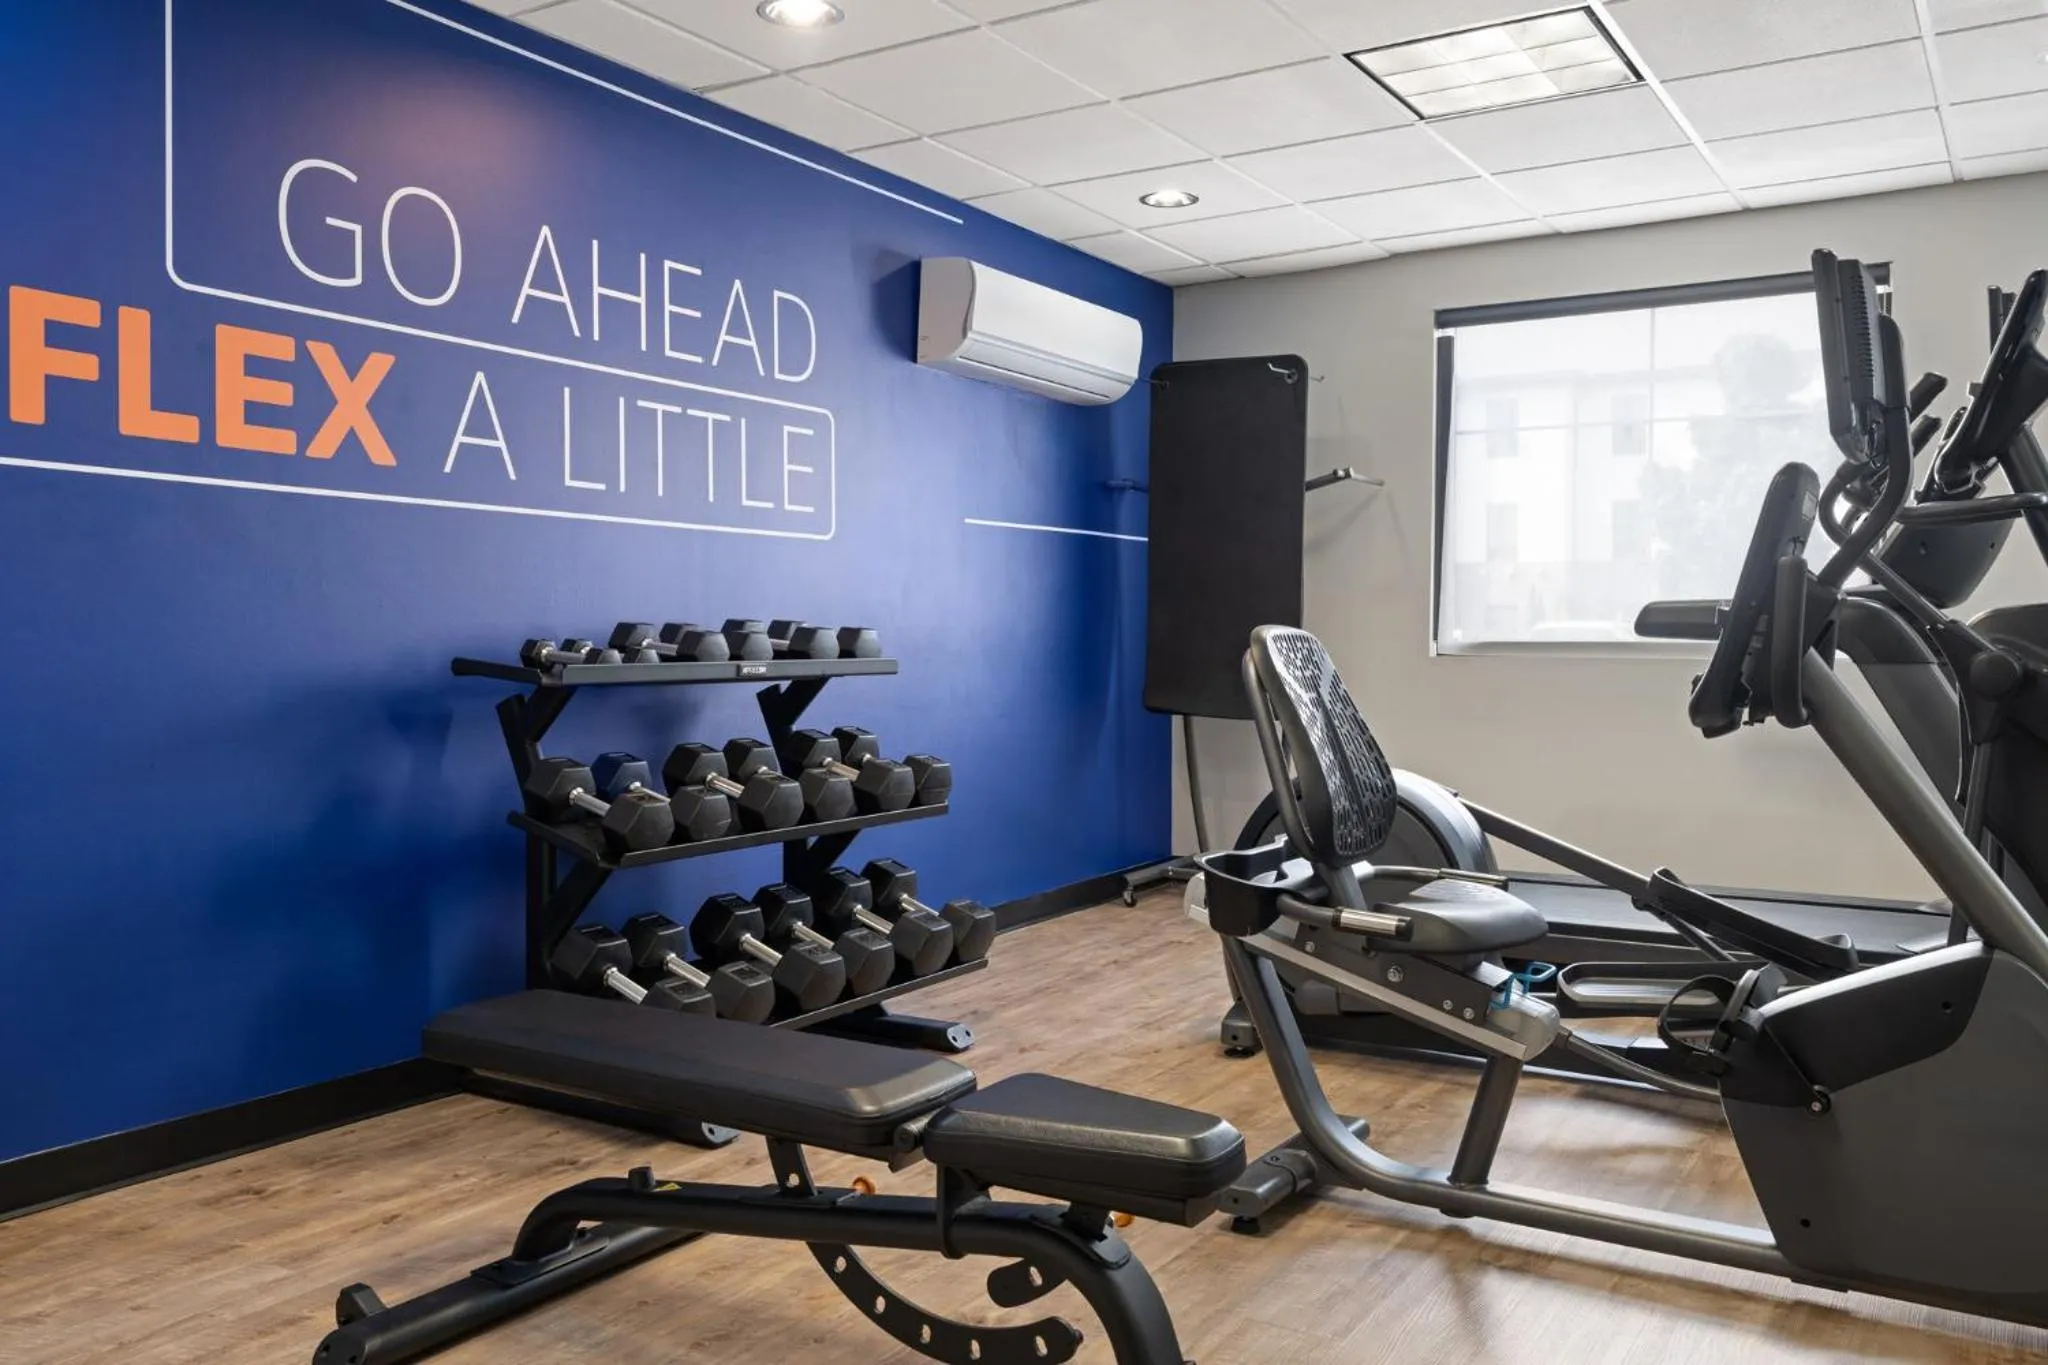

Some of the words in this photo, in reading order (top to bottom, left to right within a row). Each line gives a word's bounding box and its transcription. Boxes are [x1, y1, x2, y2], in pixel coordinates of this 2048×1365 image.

[278, 158, 463, 307] GO
[511, 224, 817, 383] AHEAD
[9, 285, 397, 466] FLEX
[443, 370, 517, 481] A
[563, 386, 815, 513] LITTLE
